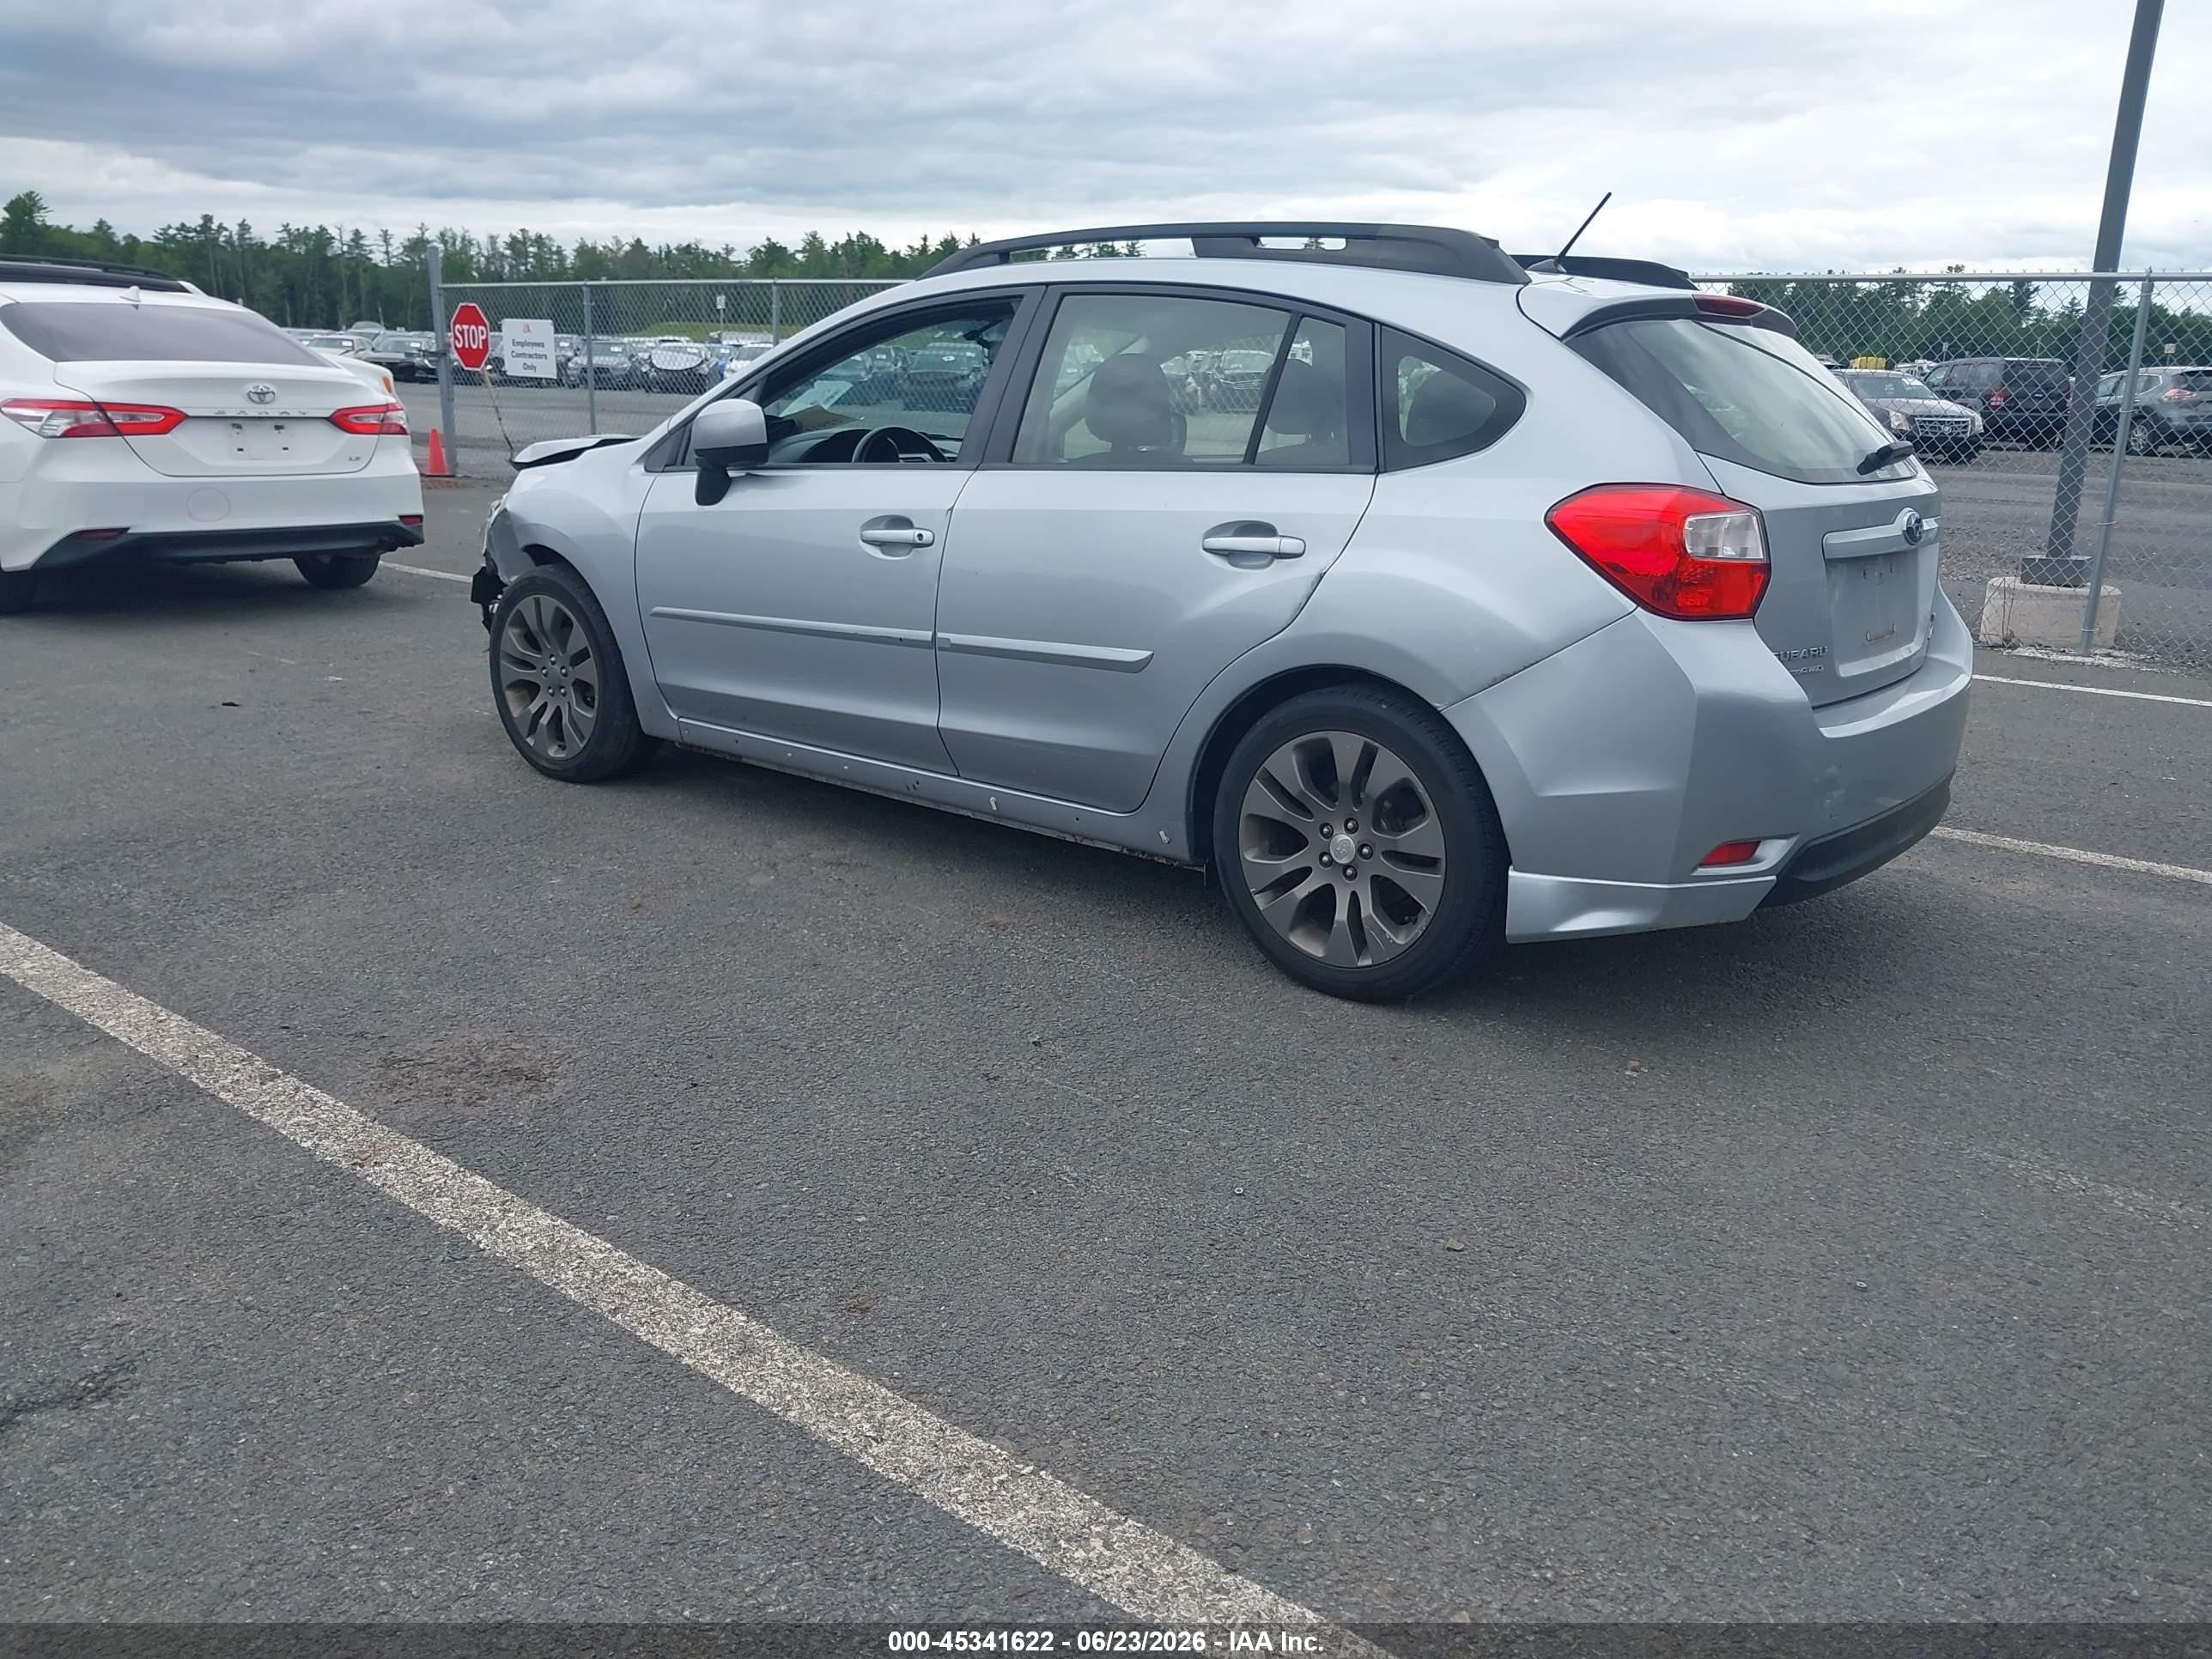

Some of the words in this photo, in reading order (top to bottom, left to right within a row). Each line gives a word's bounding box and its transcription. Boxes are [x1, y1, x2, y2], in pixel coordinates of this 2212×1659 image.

[454, 324, 487, 349] STOP
[512, 338, 544, 349] Employees
[511, 350, 548, 360] Contractors
[523, 362, 537, 373] Only
